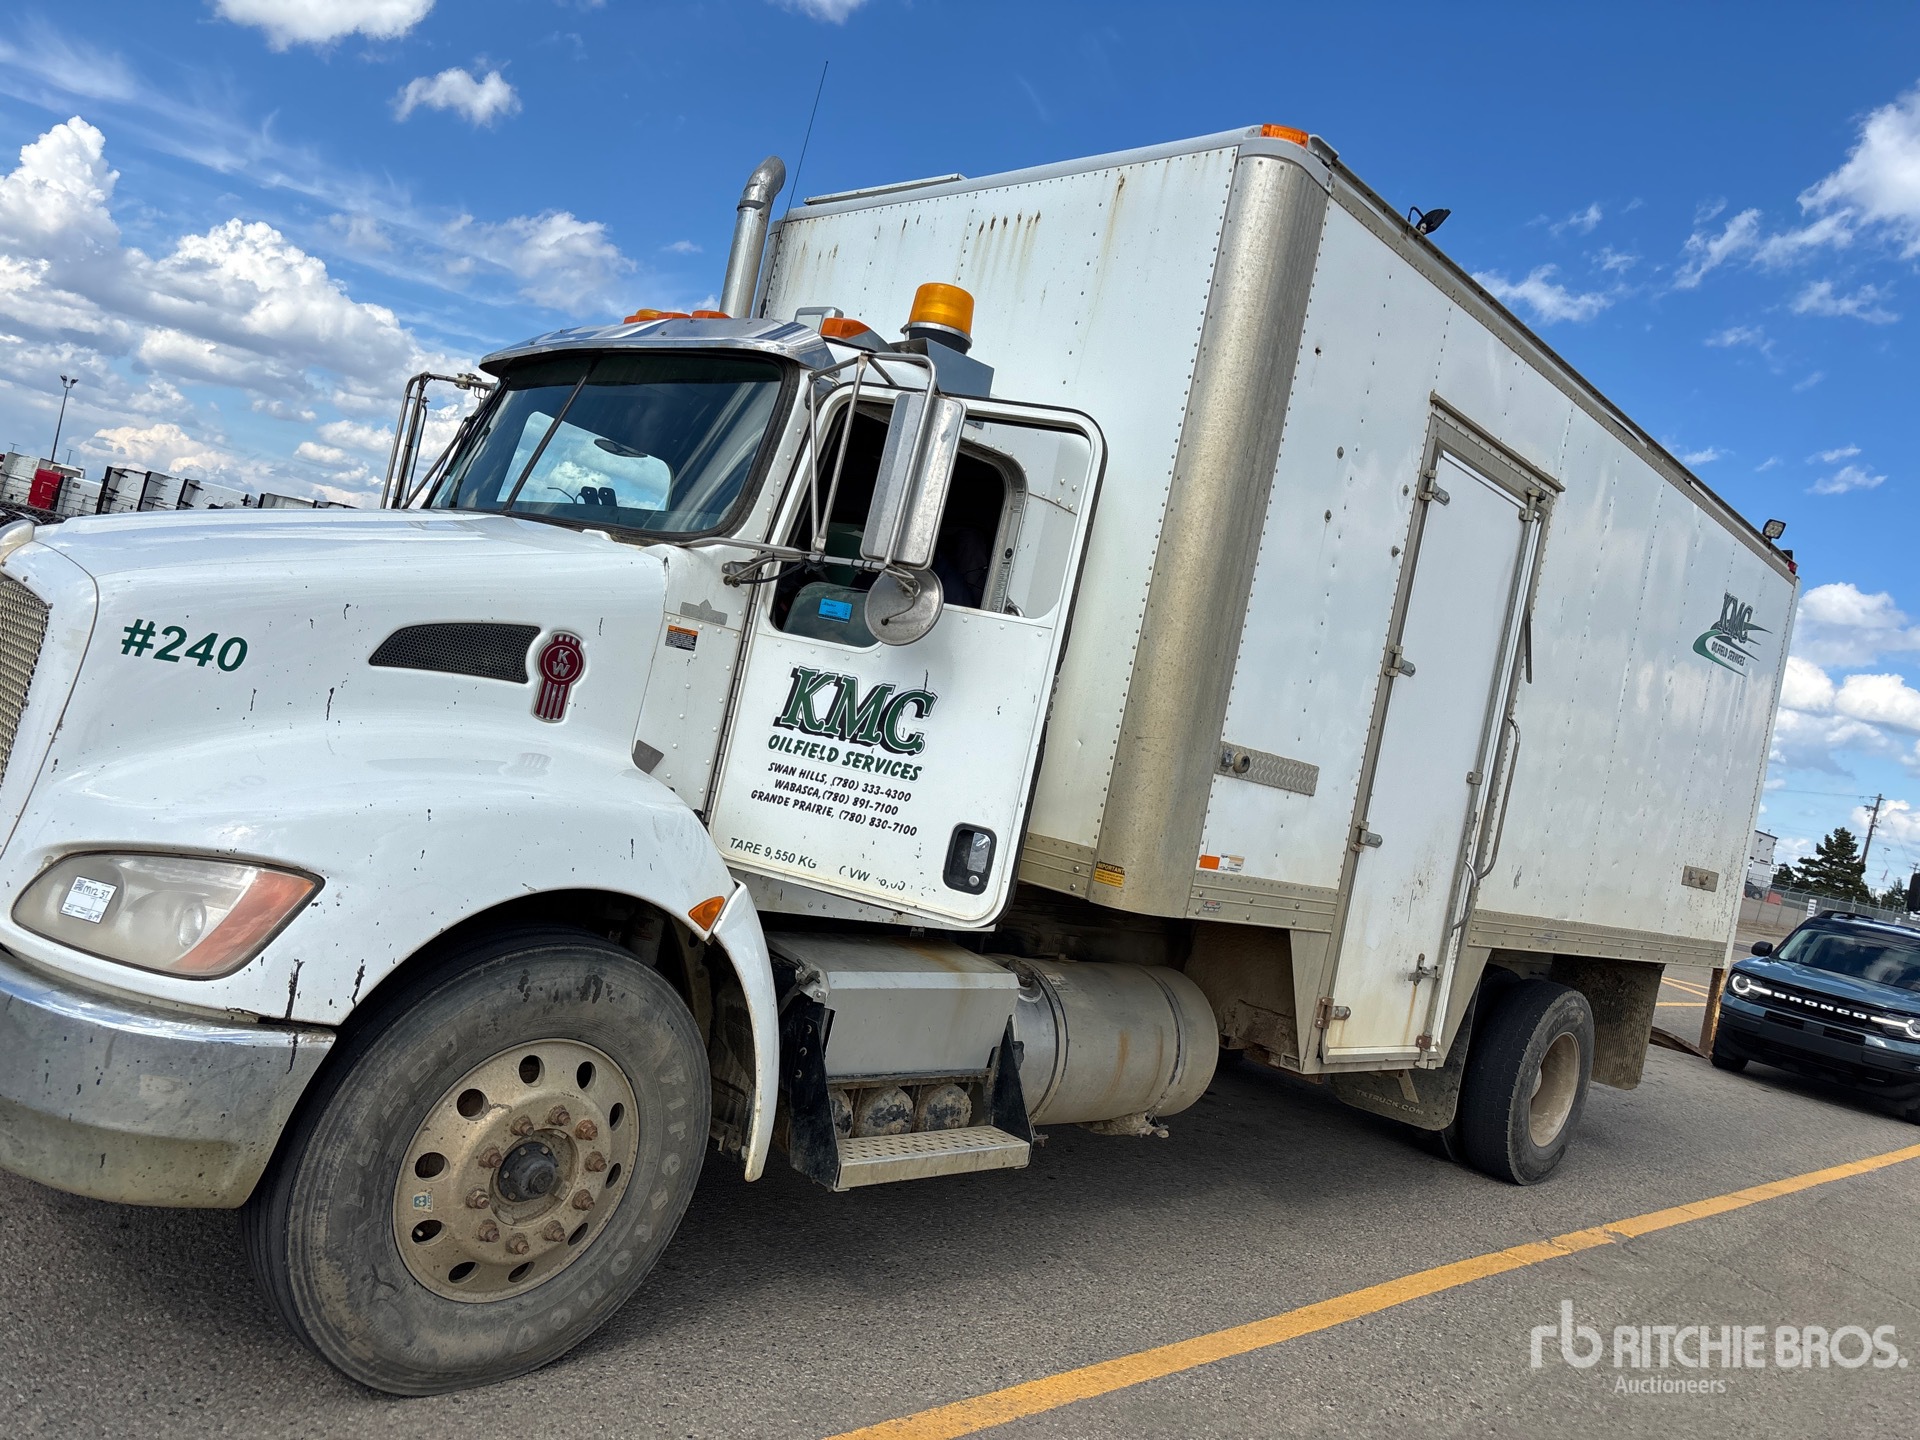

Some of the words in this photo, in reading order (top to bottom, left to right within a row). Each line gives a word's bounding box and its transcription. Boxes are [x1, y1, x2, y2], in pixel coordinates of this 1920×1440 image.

[1716, 592, 1753, 644] KMC
[121, 618, 248, 672] #240
[1711, 641, 1728, 658] OILFIELD
[1727, 650, 1746, 667] SERVICES
[773, 666, 938, 756] KMC
[768, 734, 839, 762] OILFIELD
[842, 751, 923, 781] SERVICES
[768, 762, 797, 776] SWAN
[799, 769, 828, 785] HILLS,
[832, 776, 860, 791] (780)
[862, 783, 912, 802] 333-4300
[774, 779, 821, 799] WABASCA,
[822, 789, 850, 804] (780)
[852, 797, 899, 816] 891-7100
[751, 790, 791, 807] GRANDE
[792, 799, 835, 818] PRAIRIE,
[839, 809, 867, 825] (780)
[869, 816, 918, 836] 830-7100
[729, 837, 762, 855] TARE
[763, 846, 796, 864] 9,550
[798, 855, 817, 869] KG
[1773, 991, 1867, 1020] BRONCO
[550, 1064, 687, 1331] Firestone
